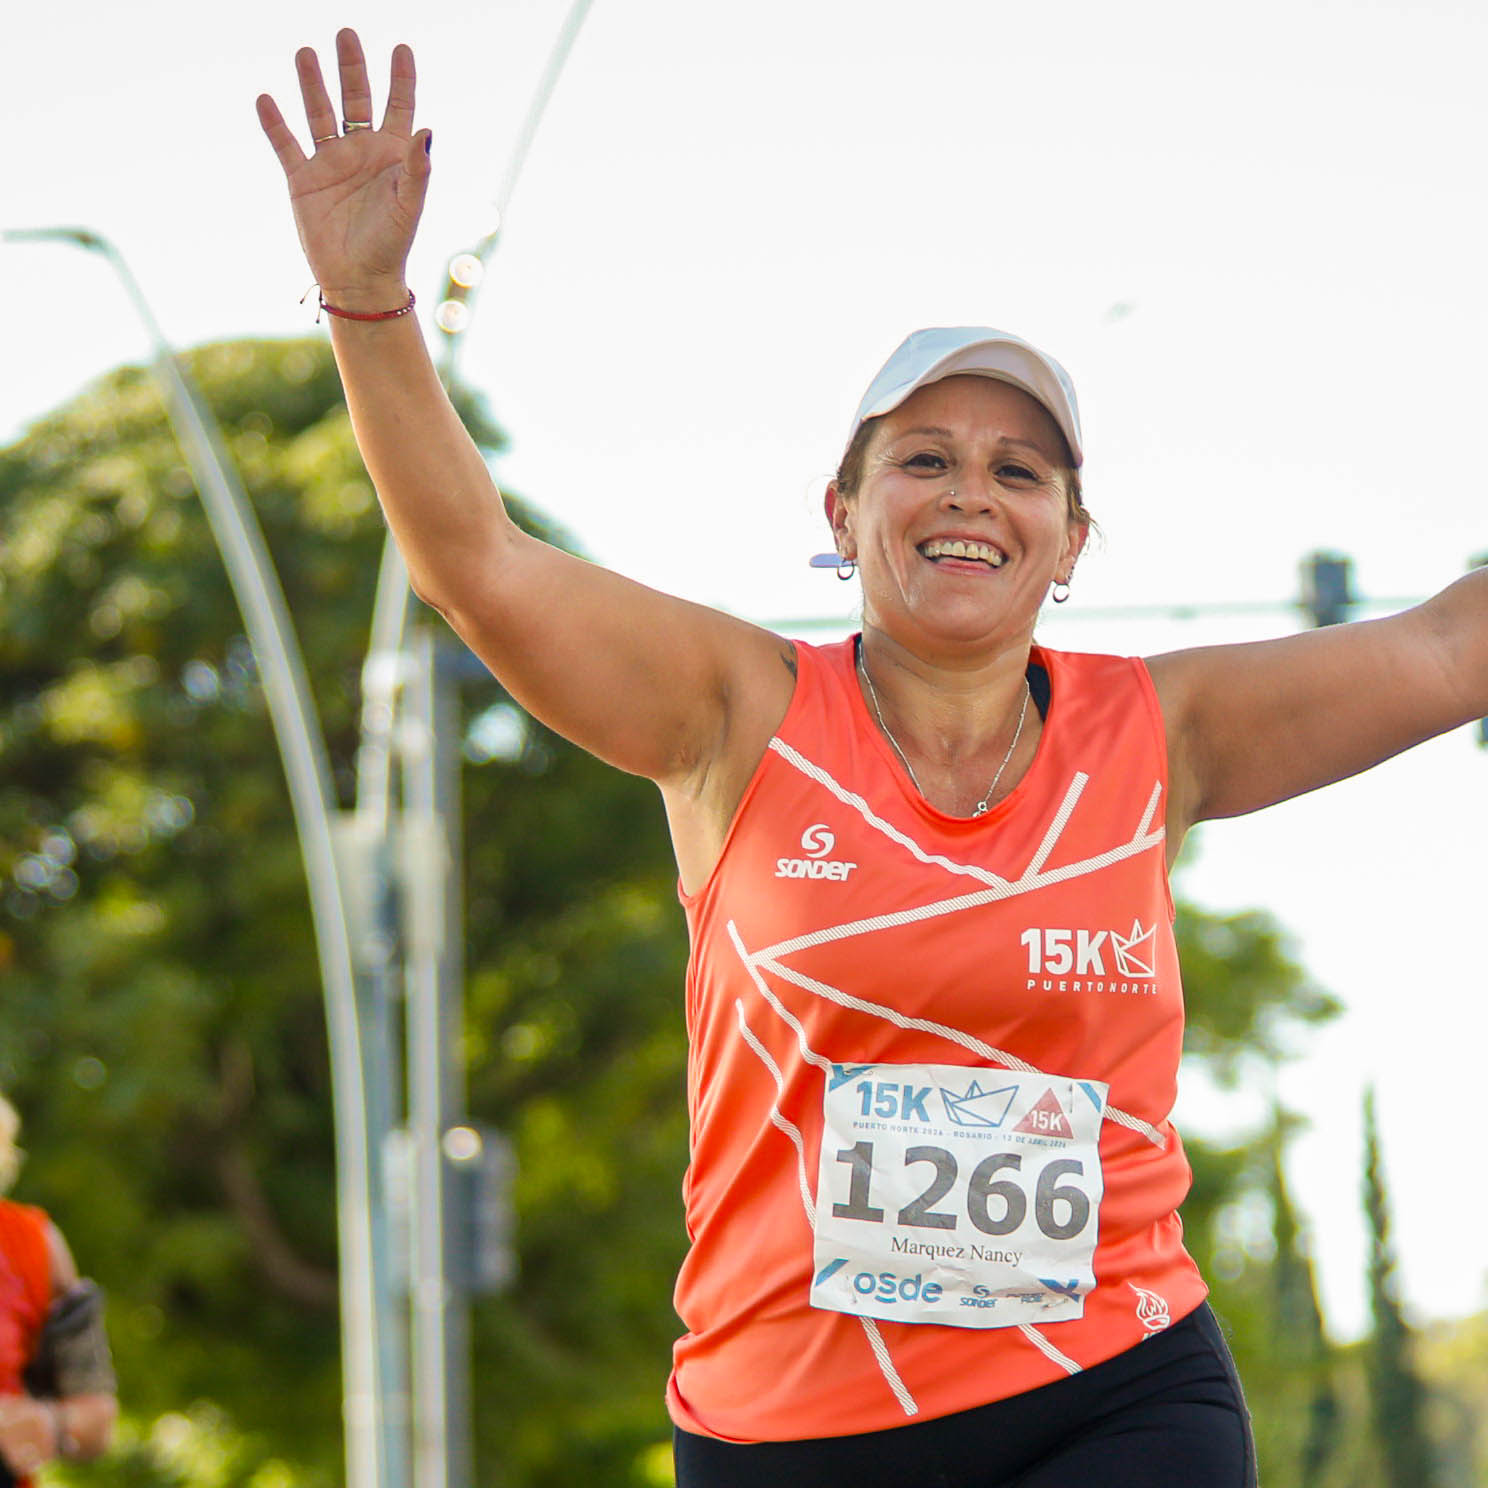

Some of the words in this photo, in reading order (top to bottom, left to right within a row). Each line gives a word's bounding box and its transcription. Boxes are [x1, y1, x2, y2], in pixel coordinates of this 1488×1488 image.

[1020, 927, 1109, 976] 15K
[856, 1080, 933, 1122] 15K
[852, 1121, 887, 1130] PUERTO
[890, 1125, 918, 1134] NORTE
[953, 1131, 992, 1140] ROSARIO
[1015, 1136, 1025, 1144] DE
[1030, 1109, 1064, 1132] 15K
[831, 1141, 1091, 1241] 1266
[891, 1236, 966, 1260] Marquez
[970, 1244, 1024, 1267] Nancy
[853, 1272, 943, 1304] osde
